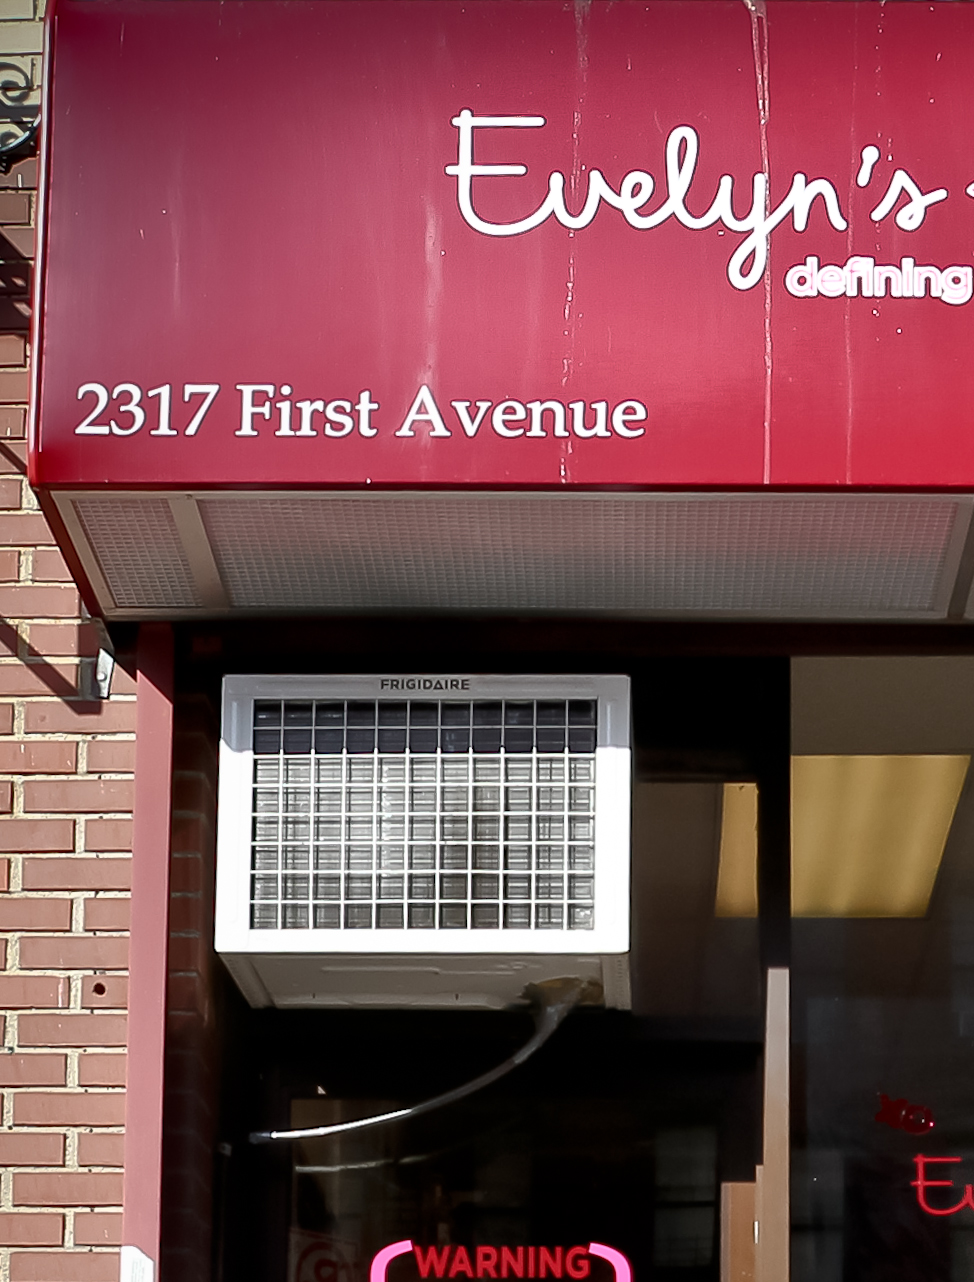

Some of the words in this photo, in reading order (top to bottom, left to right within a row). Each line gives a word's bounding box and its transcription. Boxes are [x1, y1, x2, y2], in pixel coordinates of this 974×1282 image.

[444, 109, 949, 292] Evelyn's
[785, 256, 974, 305] defining
[74, 383, 221, 440] 2317
[235, 384, 380, 440] First
[394, 384, 649, 440] Avenue
[379, 678, 471, 691] FRIGIDAIRE
[413, 1245, 592, 1280] WARNING
